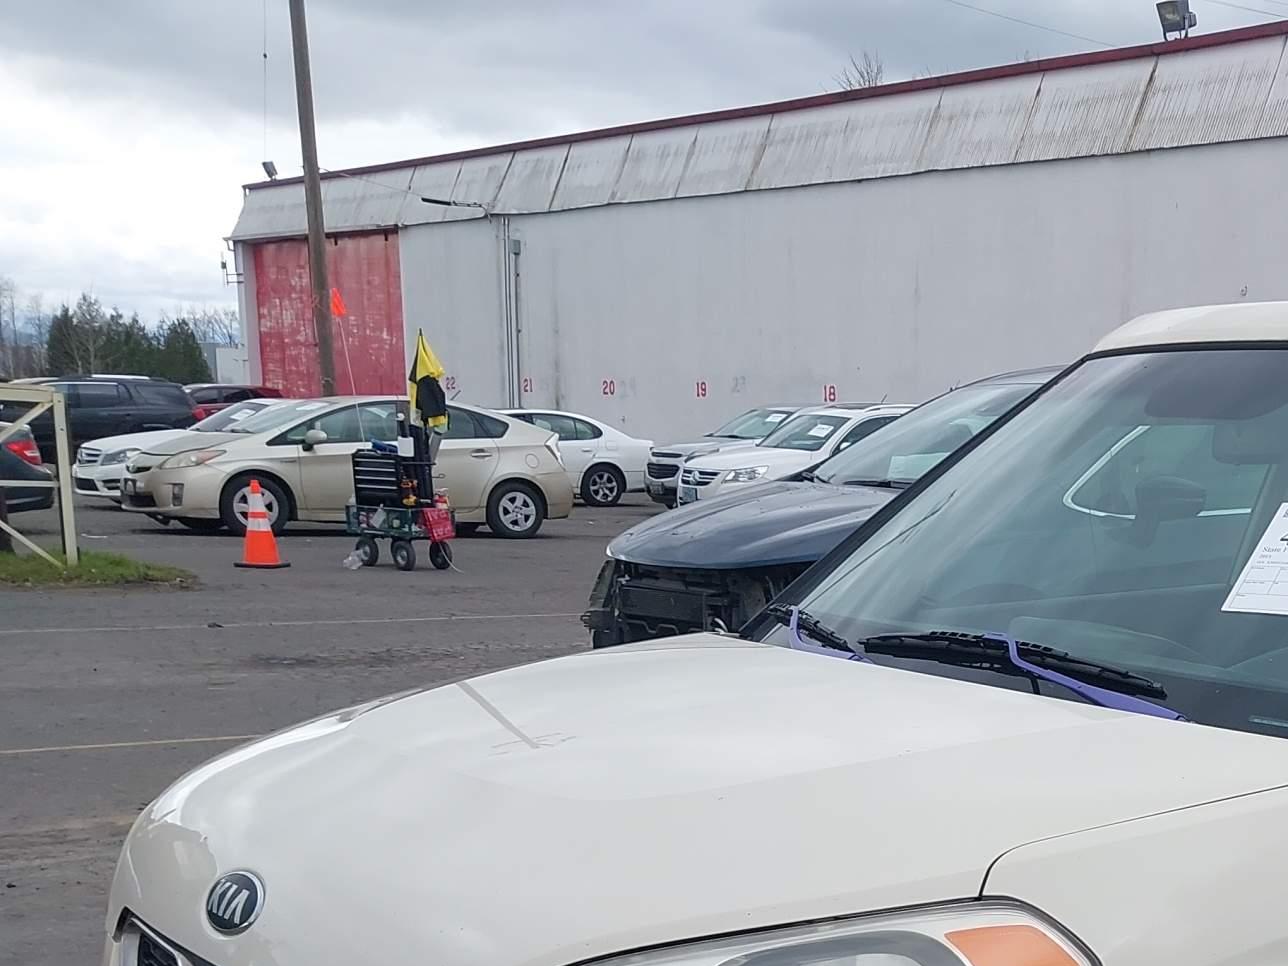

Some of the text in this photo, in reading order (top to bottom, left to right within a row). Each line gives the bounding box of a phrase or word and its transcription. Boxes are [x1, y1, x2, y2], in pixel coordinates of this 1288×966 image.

[445, 376, 457, 390] 22
[523, 378, 534, 393] 21
[602, 380, 616, 396] 20
[696, 381, 708, 397] 19
[823, 384, 837, 402] 18
[208, 879, 250, 924] KIA
